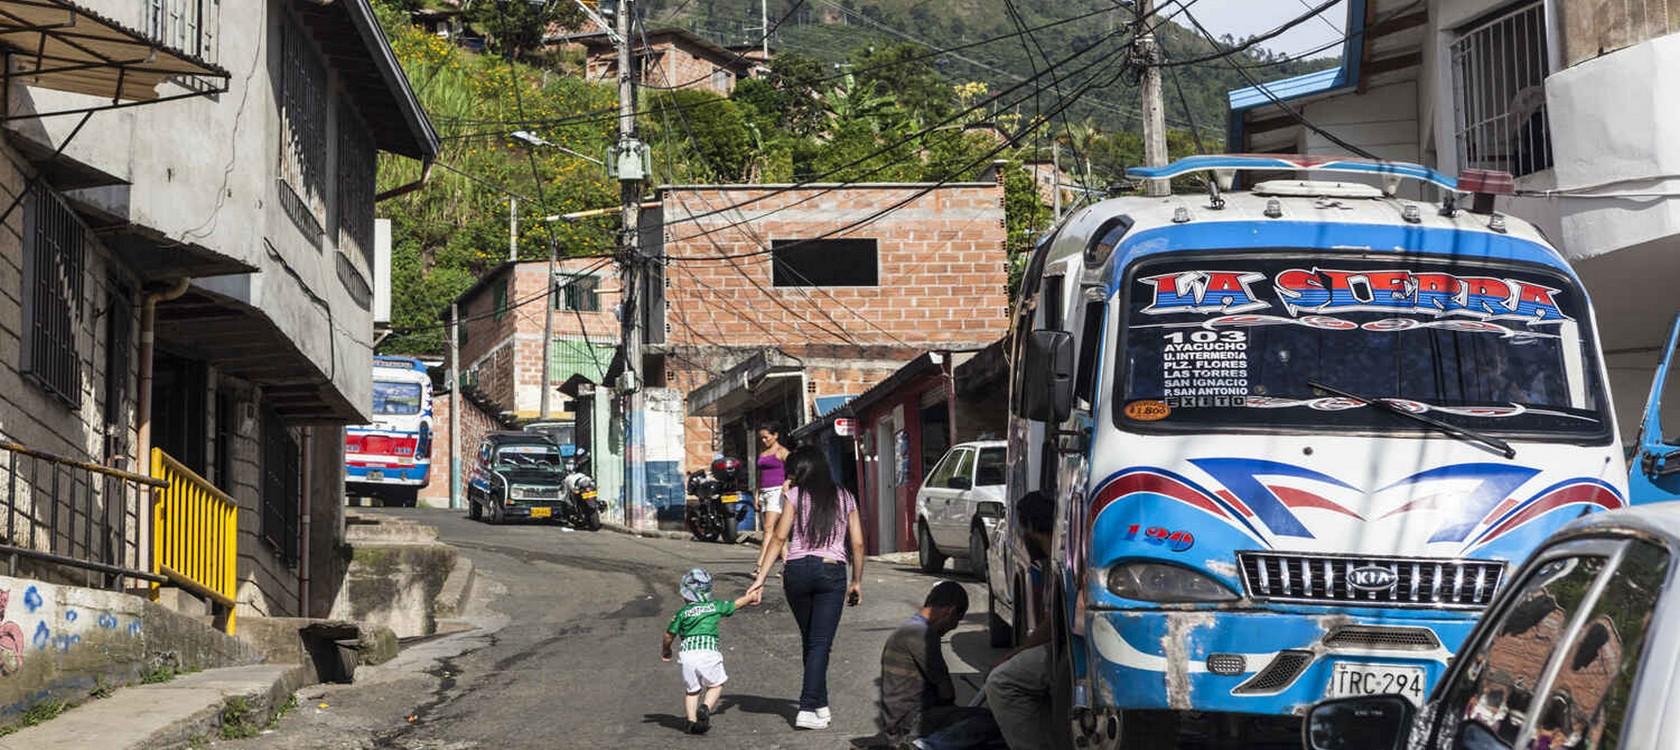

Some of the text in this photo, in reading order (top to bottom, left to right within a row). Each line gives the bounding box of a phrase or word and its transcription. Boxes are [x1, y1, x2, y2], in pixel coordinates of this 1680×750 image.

[1138, 267, 1564, 326] LA SIERRA
[1163, 331, 1246, 343] 103
[1164, 342, 1247, 352] AYACUCHO
[1176, 351, 1248, 361] INTERMEDIA
[1163, 360, 1248, 370] PLZ. FLORES
[1164, 369, 1248, 379] LAS TORRES
[1164, 378, 1248, 388] SAN IGNACIO
[1173, 388, 1196, 396] SAN
[1197, 387, 1249, 396] ANTONIO
[1355, 571, 1390, 585] KIA
